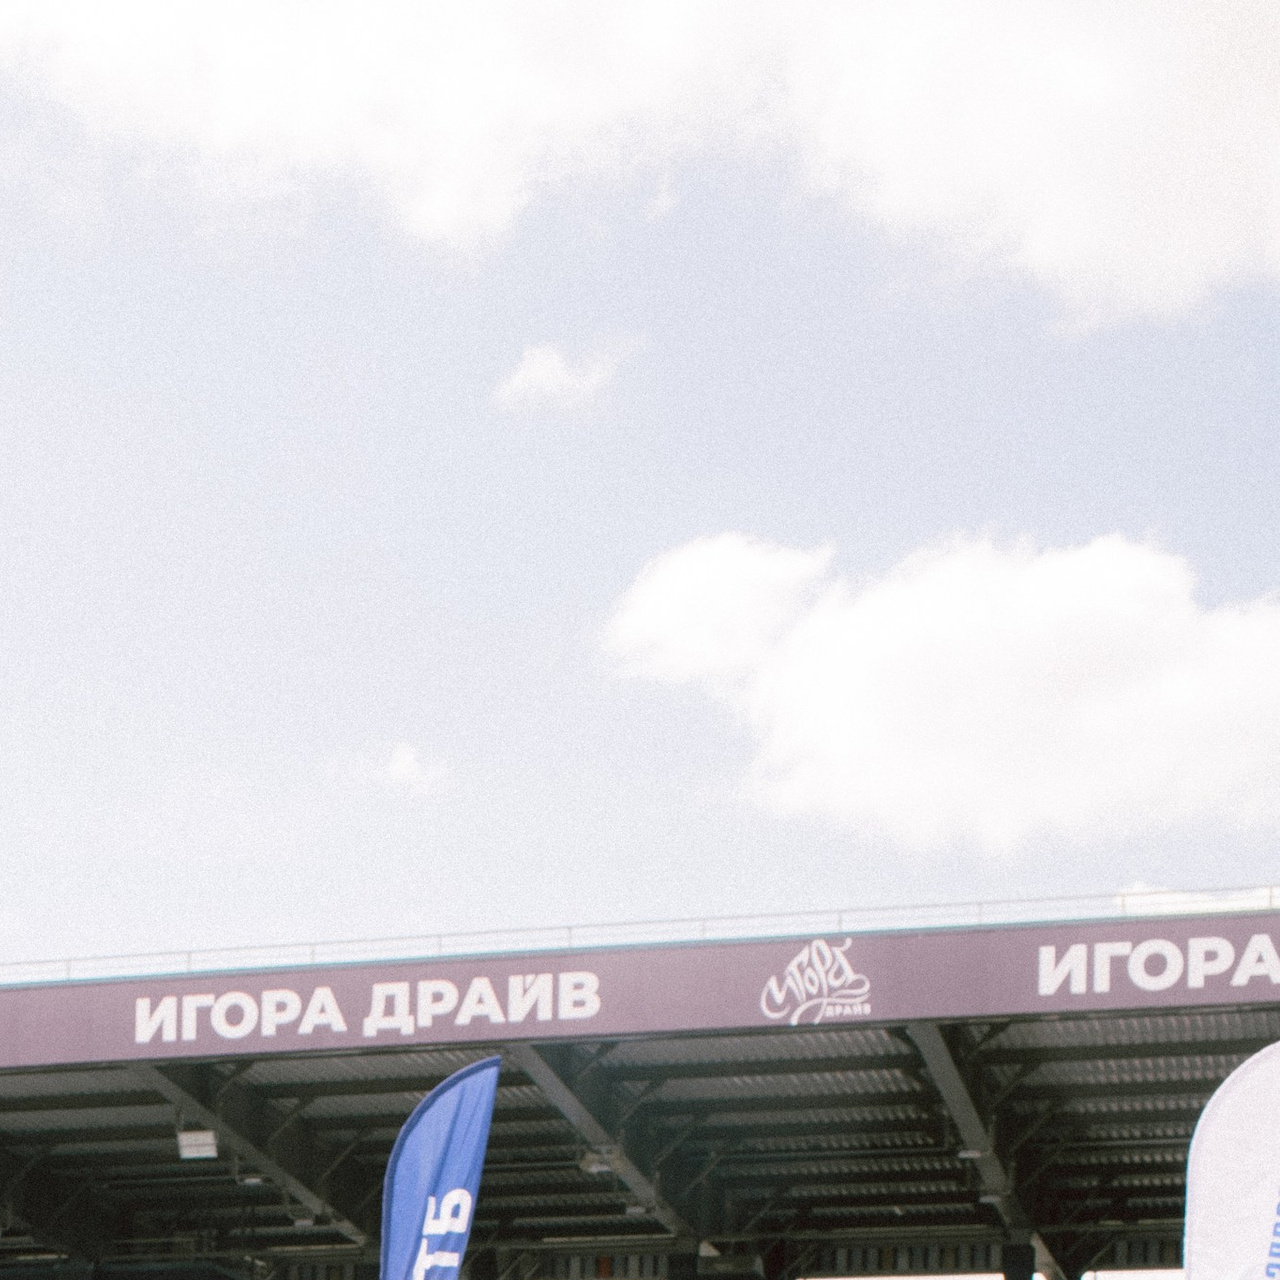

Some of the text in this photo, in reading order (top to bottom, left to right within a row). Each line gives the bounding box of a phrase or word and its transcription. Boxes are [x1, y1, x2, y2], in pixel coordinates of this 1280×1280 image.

[1038, 933, 1280, 996] ИГОРА
[134, 970, 602, 1044] ИГОРА ДРАЙВ
